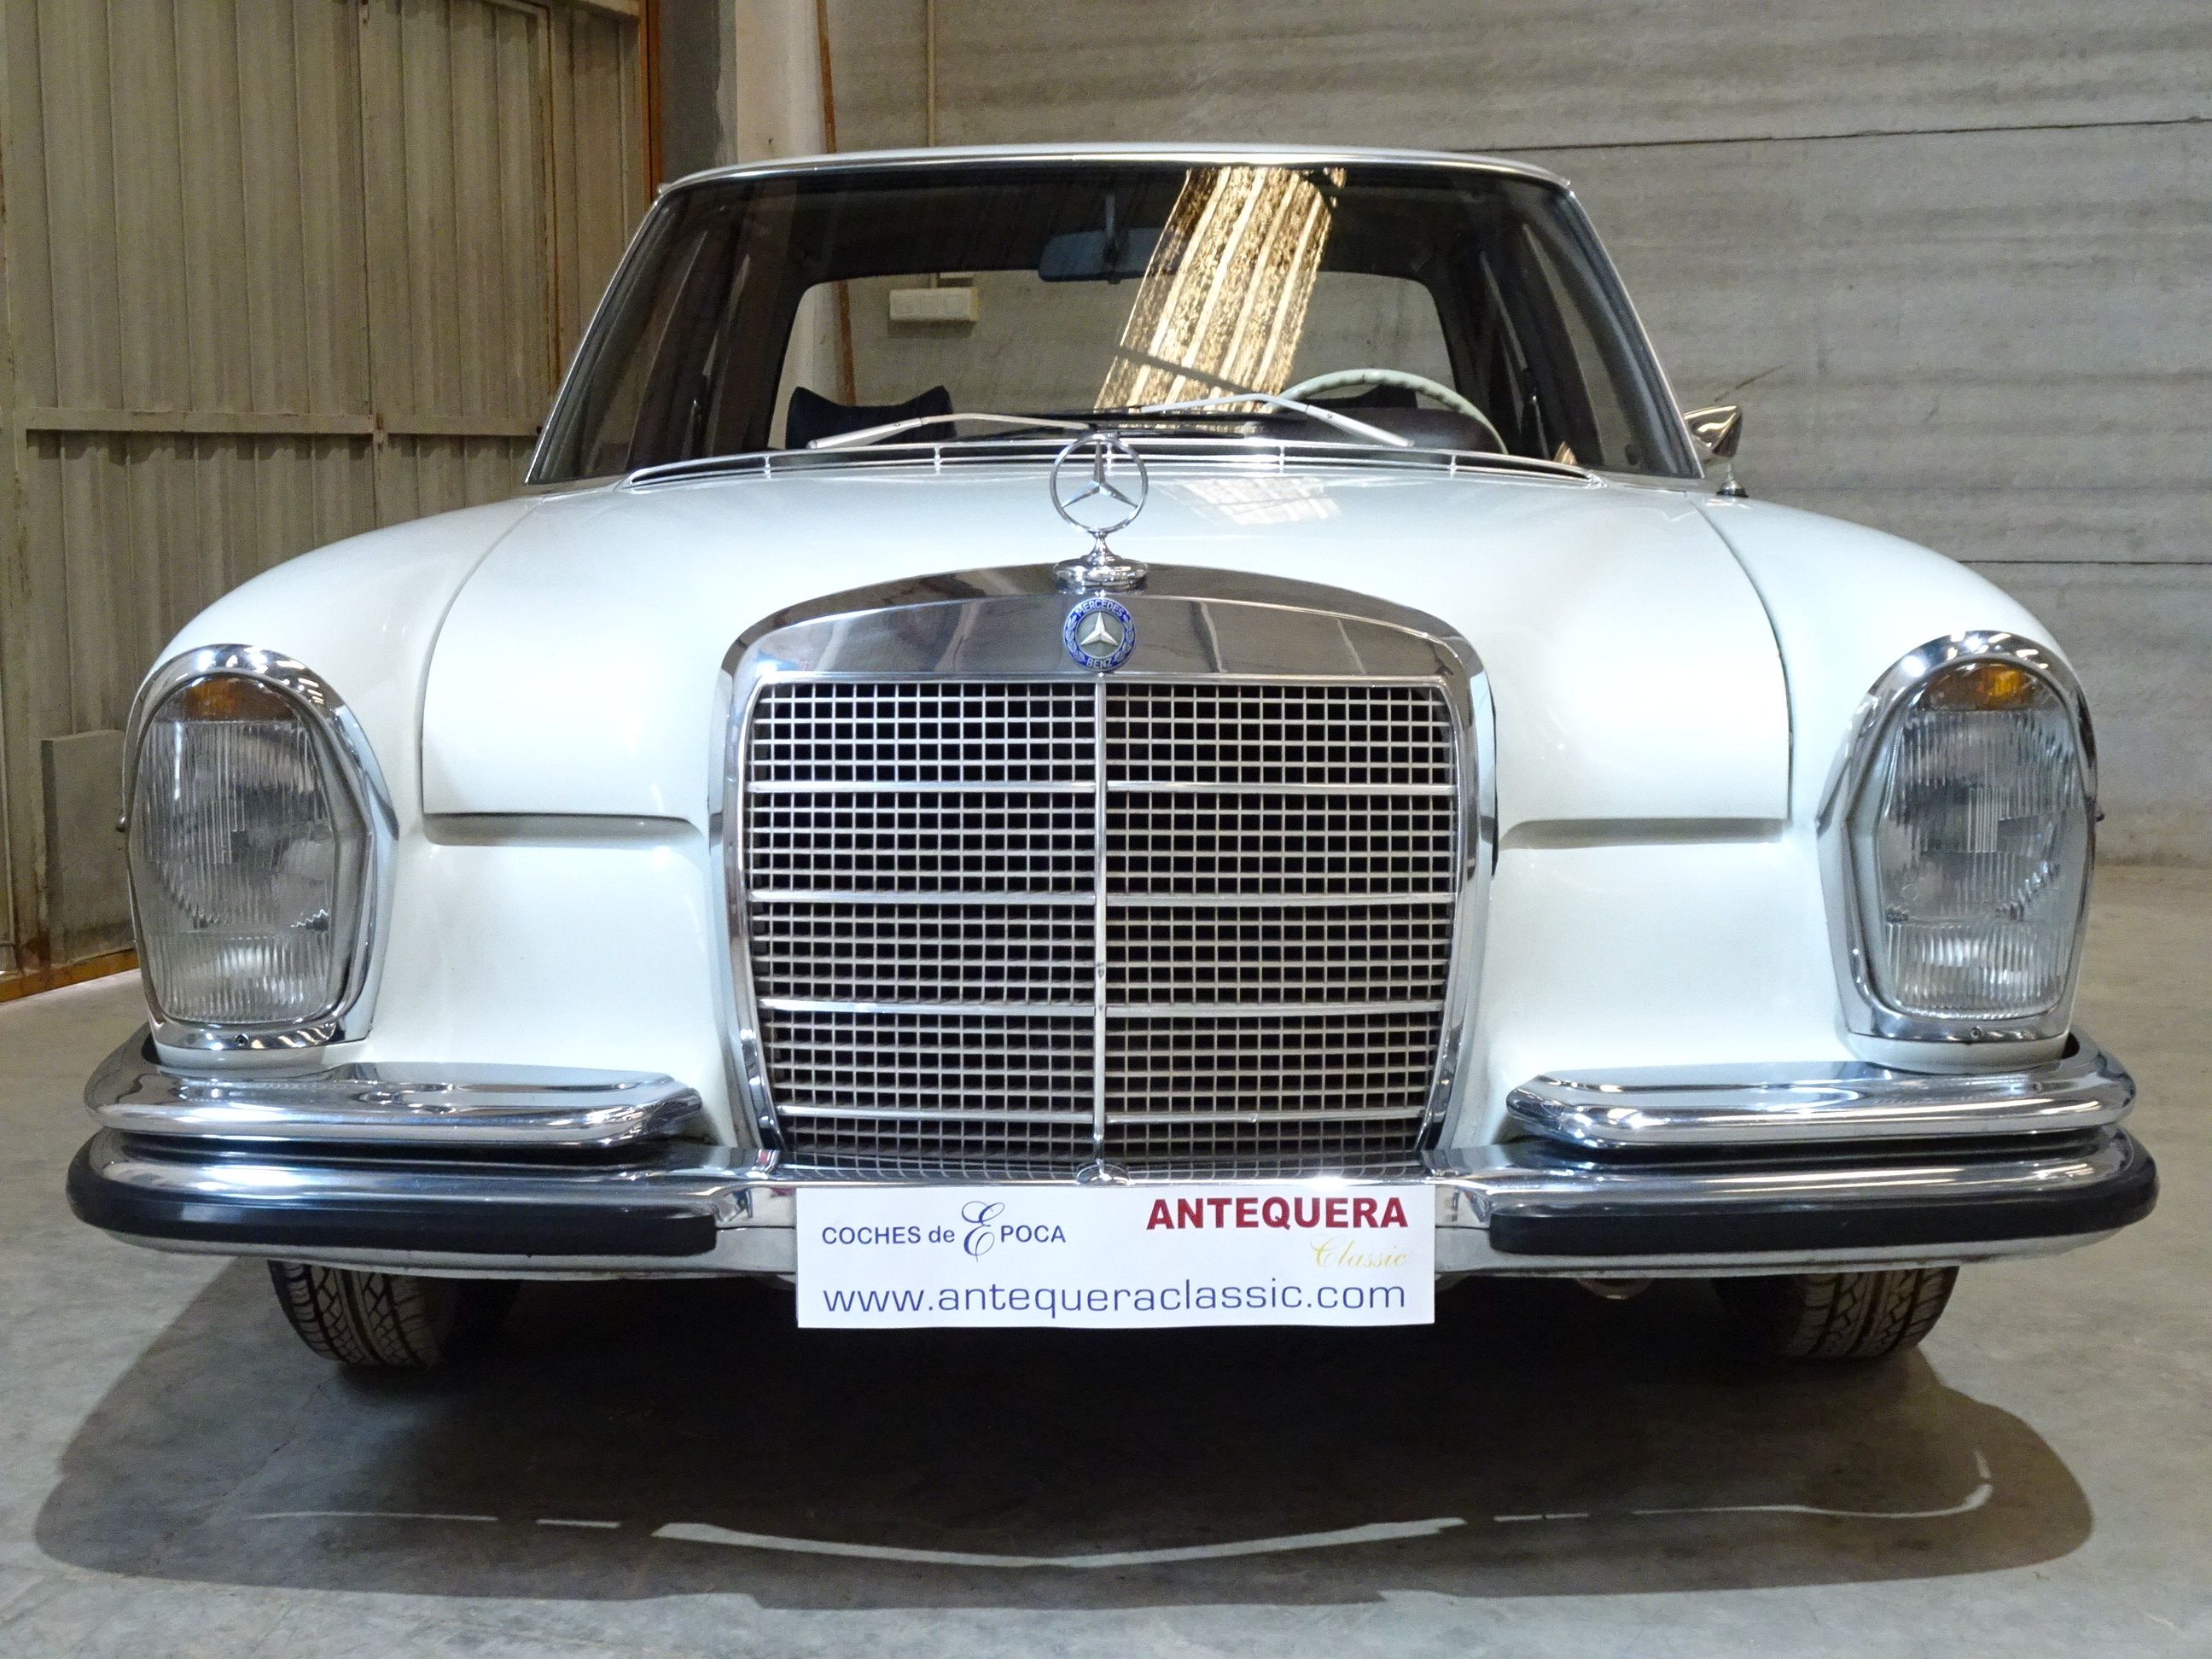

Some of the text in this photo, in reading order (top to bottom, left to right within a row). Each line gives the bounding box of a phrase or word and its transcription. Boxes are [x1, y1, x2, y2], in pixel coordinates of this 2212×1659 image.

[1075, 599, 1125, 617] MERCEDES
[1086, 658, 1113, 668] BENZ
[1146, 1196, 1409, 1231] ANTEQUERA
[822, 1225, 922, 1244] COCHES
[928, 1225, 956, 1243] de
[1310, 1234, 1407, 1269] Classic
[822, 1278, 1406, 1318] www.antequeraclassic.com
